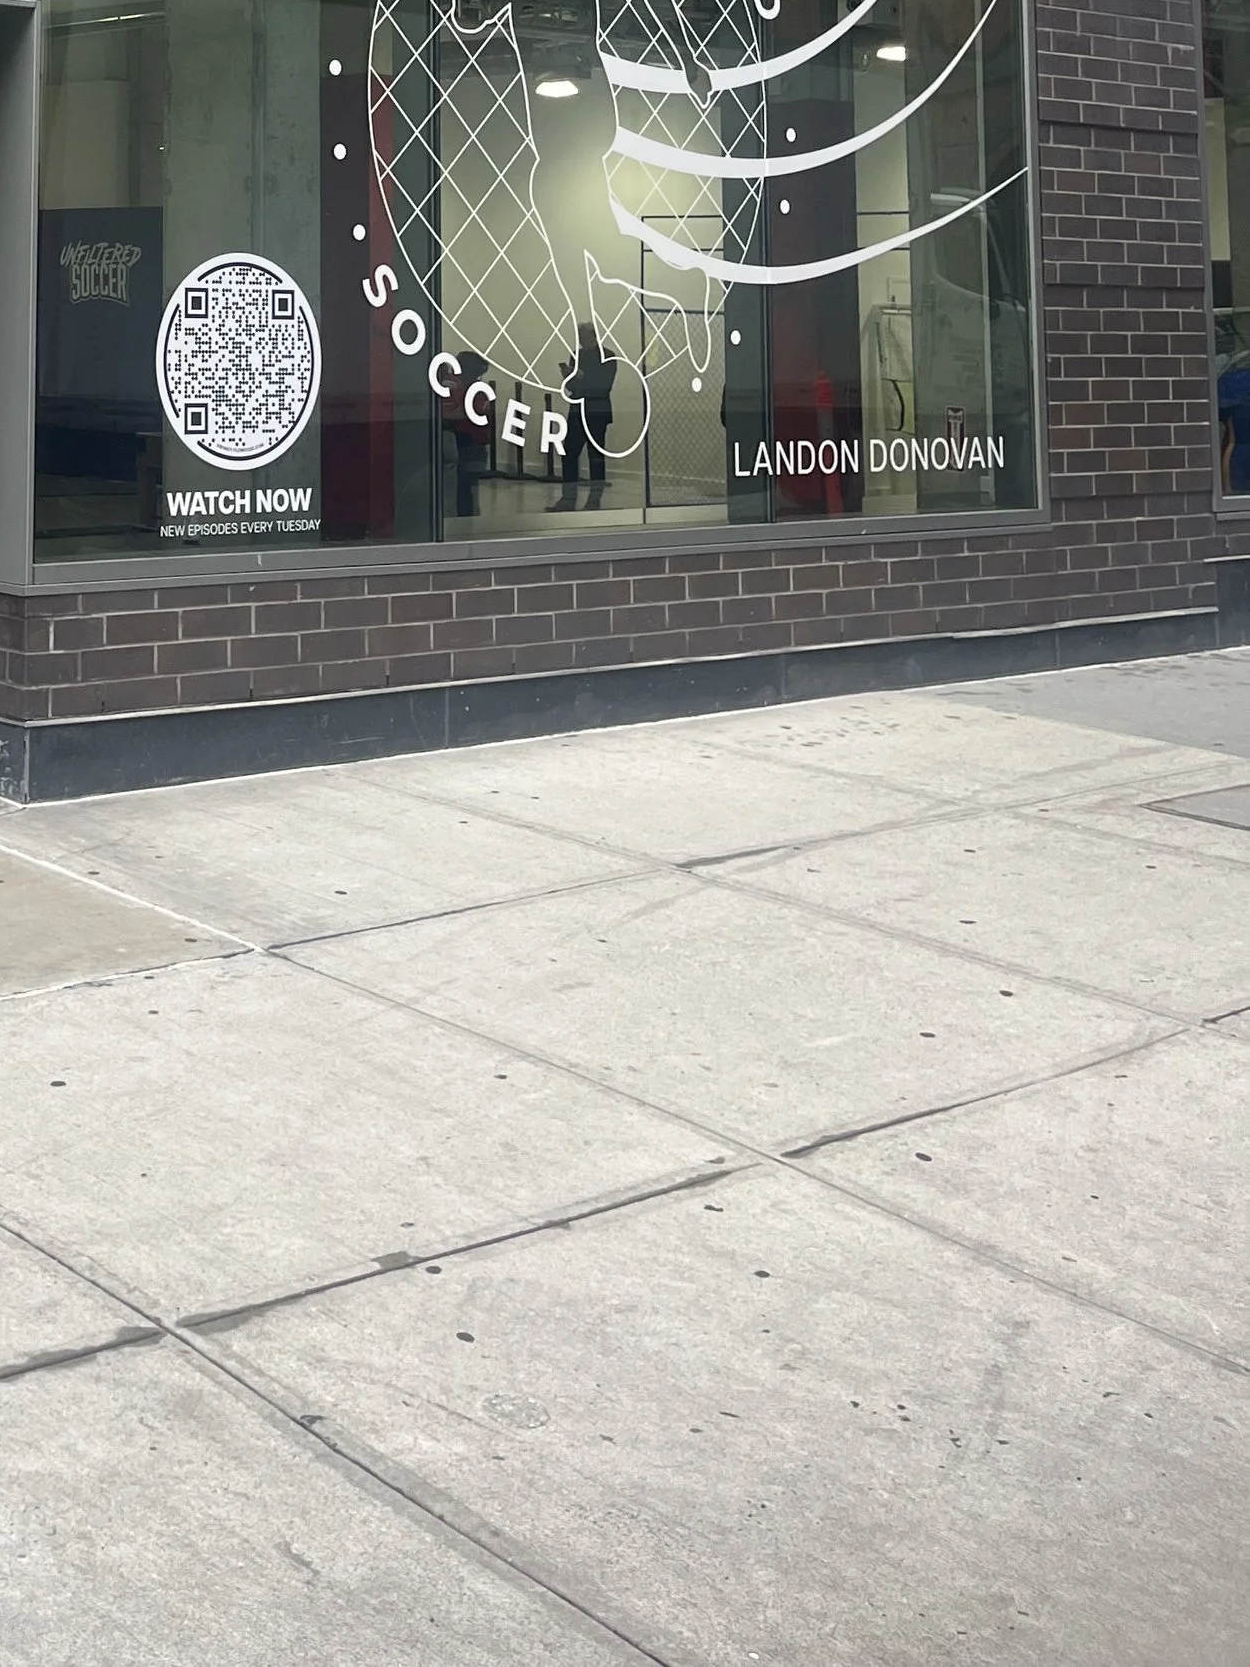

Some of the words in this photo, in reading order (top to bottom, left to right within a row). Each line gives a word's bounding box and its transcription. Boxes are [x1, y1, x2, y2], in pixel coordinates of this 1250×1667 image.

[60, 239, 142, 268] UNFILTERED
[72, 264, 127, 301] SOCCER
[362, 264, 568, 456] SOCCER
[734, 439, 859, 477] LANDON
[869, 436, 1004, 473] DONOVAN
[166, 490, 251, 517] WATCH
[256, 488, 313, 513] NOW
[160, 525, 186, 537] NEW
[188, 522, 238, 536] EPISODES
[240, 520, 274, 533] EVERY
[276, 518, 321, 532] TUESDAY
